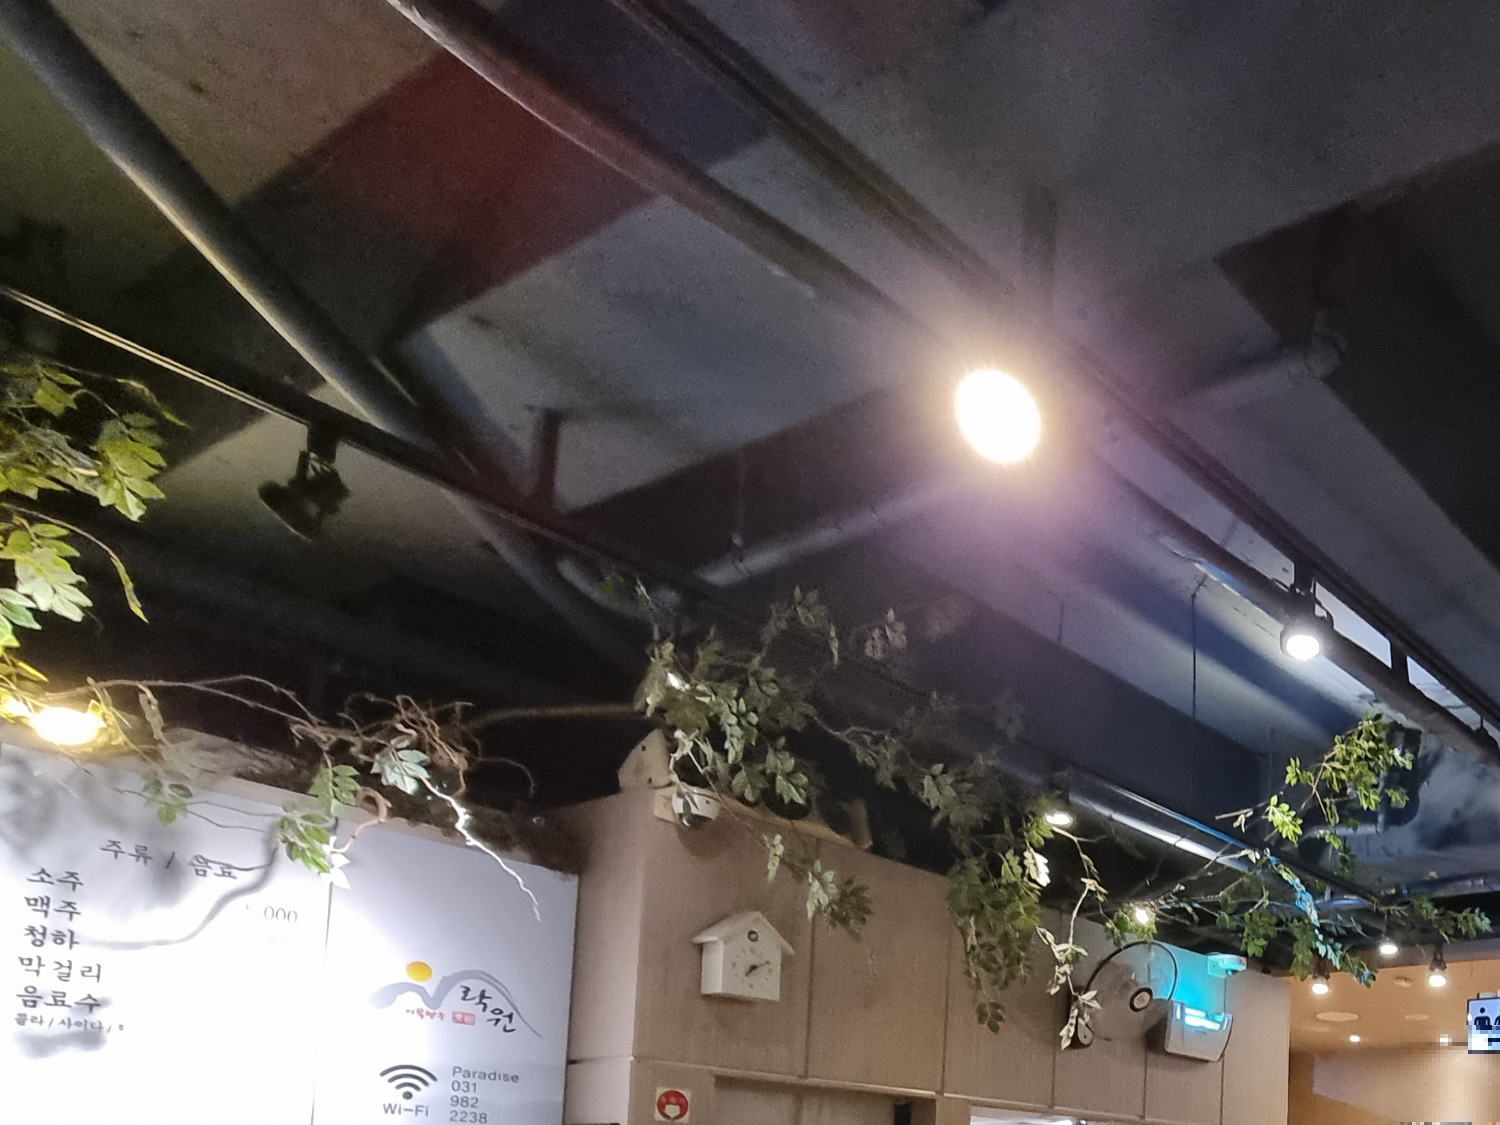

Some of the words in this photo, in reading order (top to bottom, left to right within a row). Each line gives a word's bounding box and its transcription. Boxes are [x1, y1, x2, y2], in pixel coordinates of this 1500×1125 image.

[100, 839, 152, 866] 주류
[27, 867, 83, 892] 소주
[24, 895, 81, 922] 맥주
[23, 925, 79, 950] 청하
[18, 955, 102, 983] 막걸리
[16, 985, 102, 1013] 음료수
[451, 1081, 478, 1093] 031
[452, 1066, 519, 1083] Paradise
[383, 1103, 429, 1117] Wi-Fi
[450, 1095, 479, 1108] 982
[449, 1110, 488, 1124] 2238
